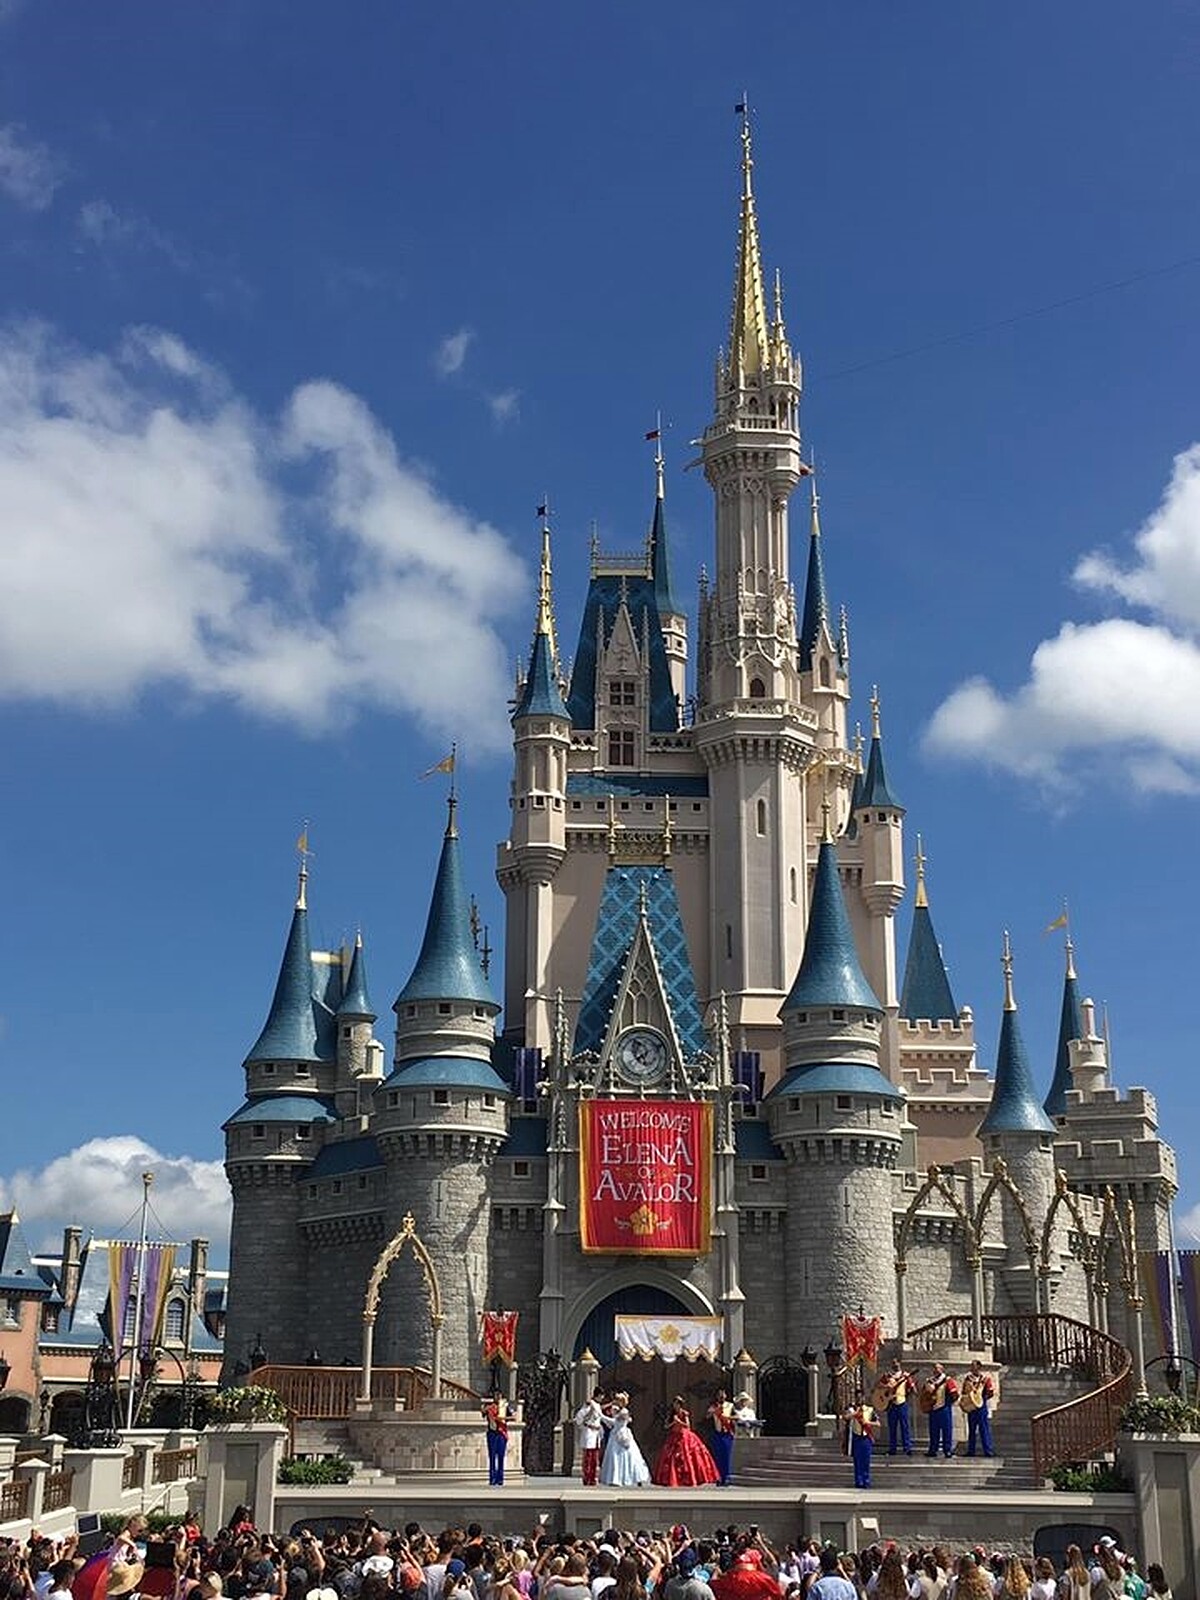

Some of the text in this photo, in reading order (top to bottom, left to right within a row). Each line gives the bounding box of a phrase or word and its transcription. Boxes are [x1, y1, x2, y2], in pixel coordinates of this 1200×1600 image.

[600, 1111, 692, 1133] WELCOME
[602, 1134, 693, 1166] ELENA
[593, 1169, 697, 1203] AVALOR
